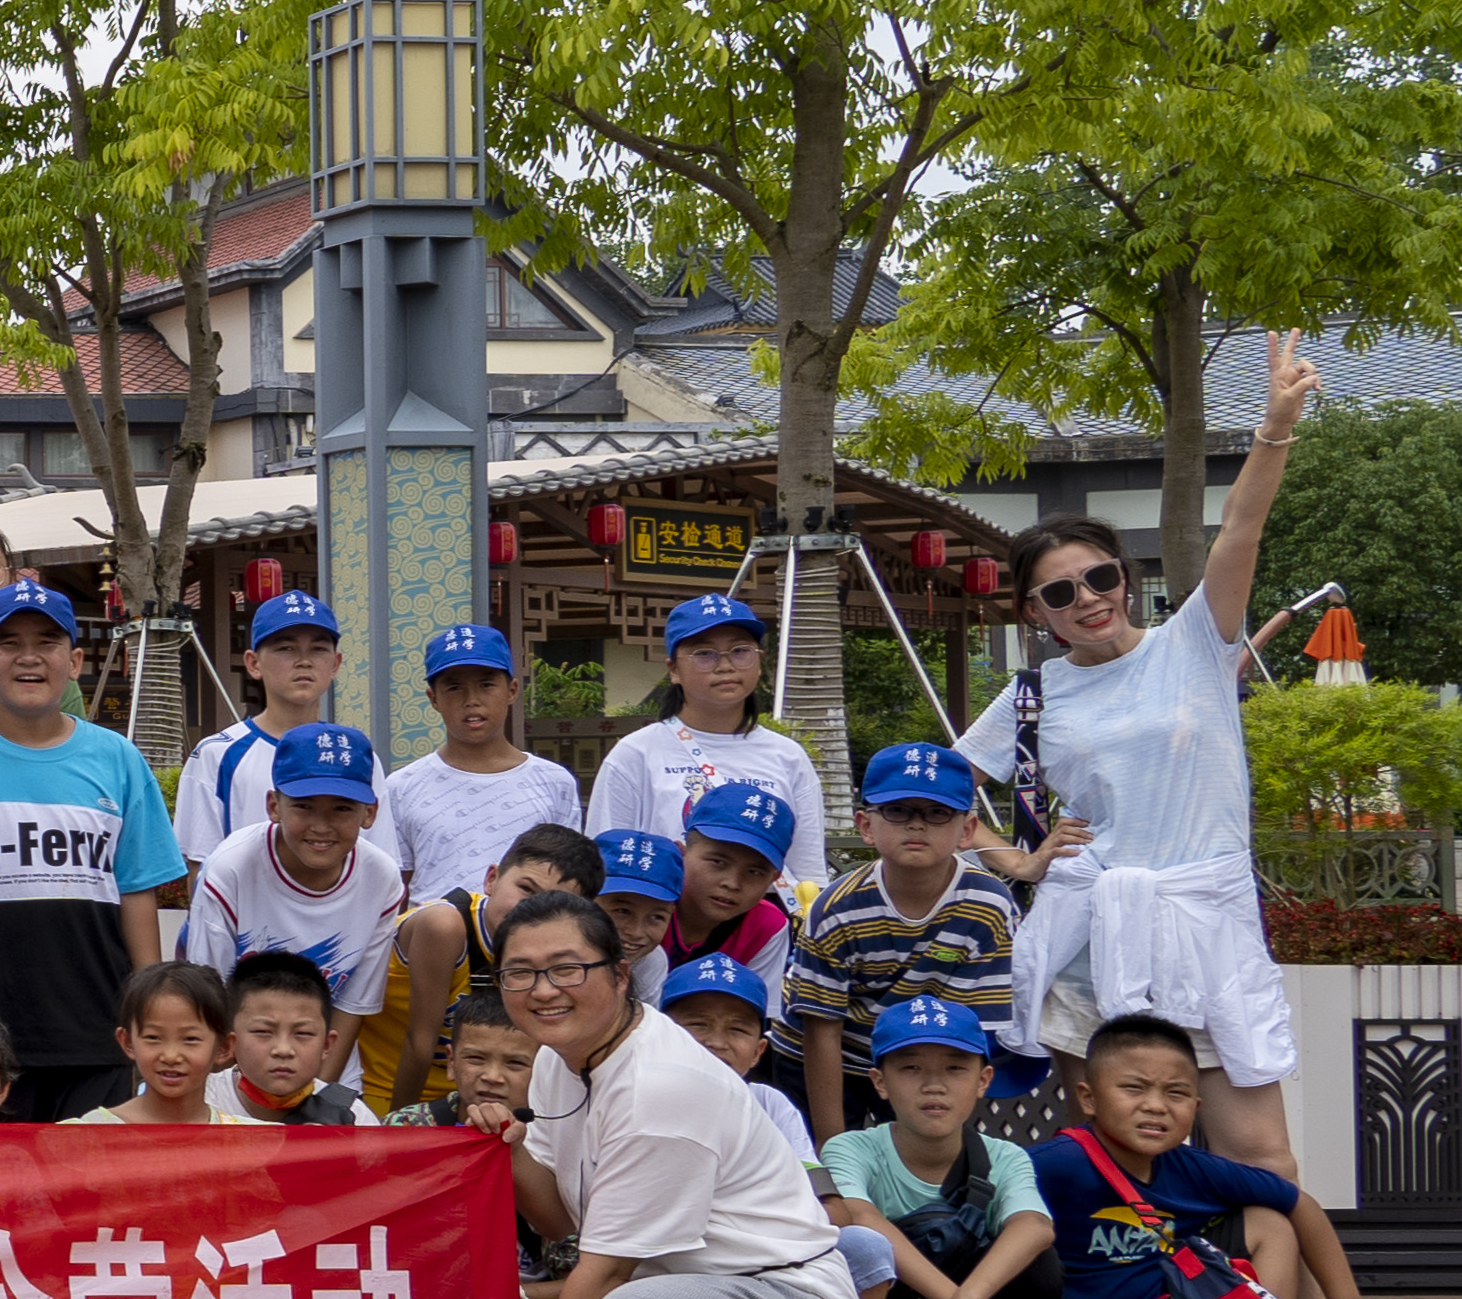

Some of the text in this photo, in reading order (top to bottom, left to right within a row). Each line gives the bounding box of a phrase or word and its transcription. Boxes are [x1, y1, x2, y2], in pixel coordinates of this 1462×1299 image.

[658, 520, 746, 551] 安检通道
[15, 581, 47, 594] 德
